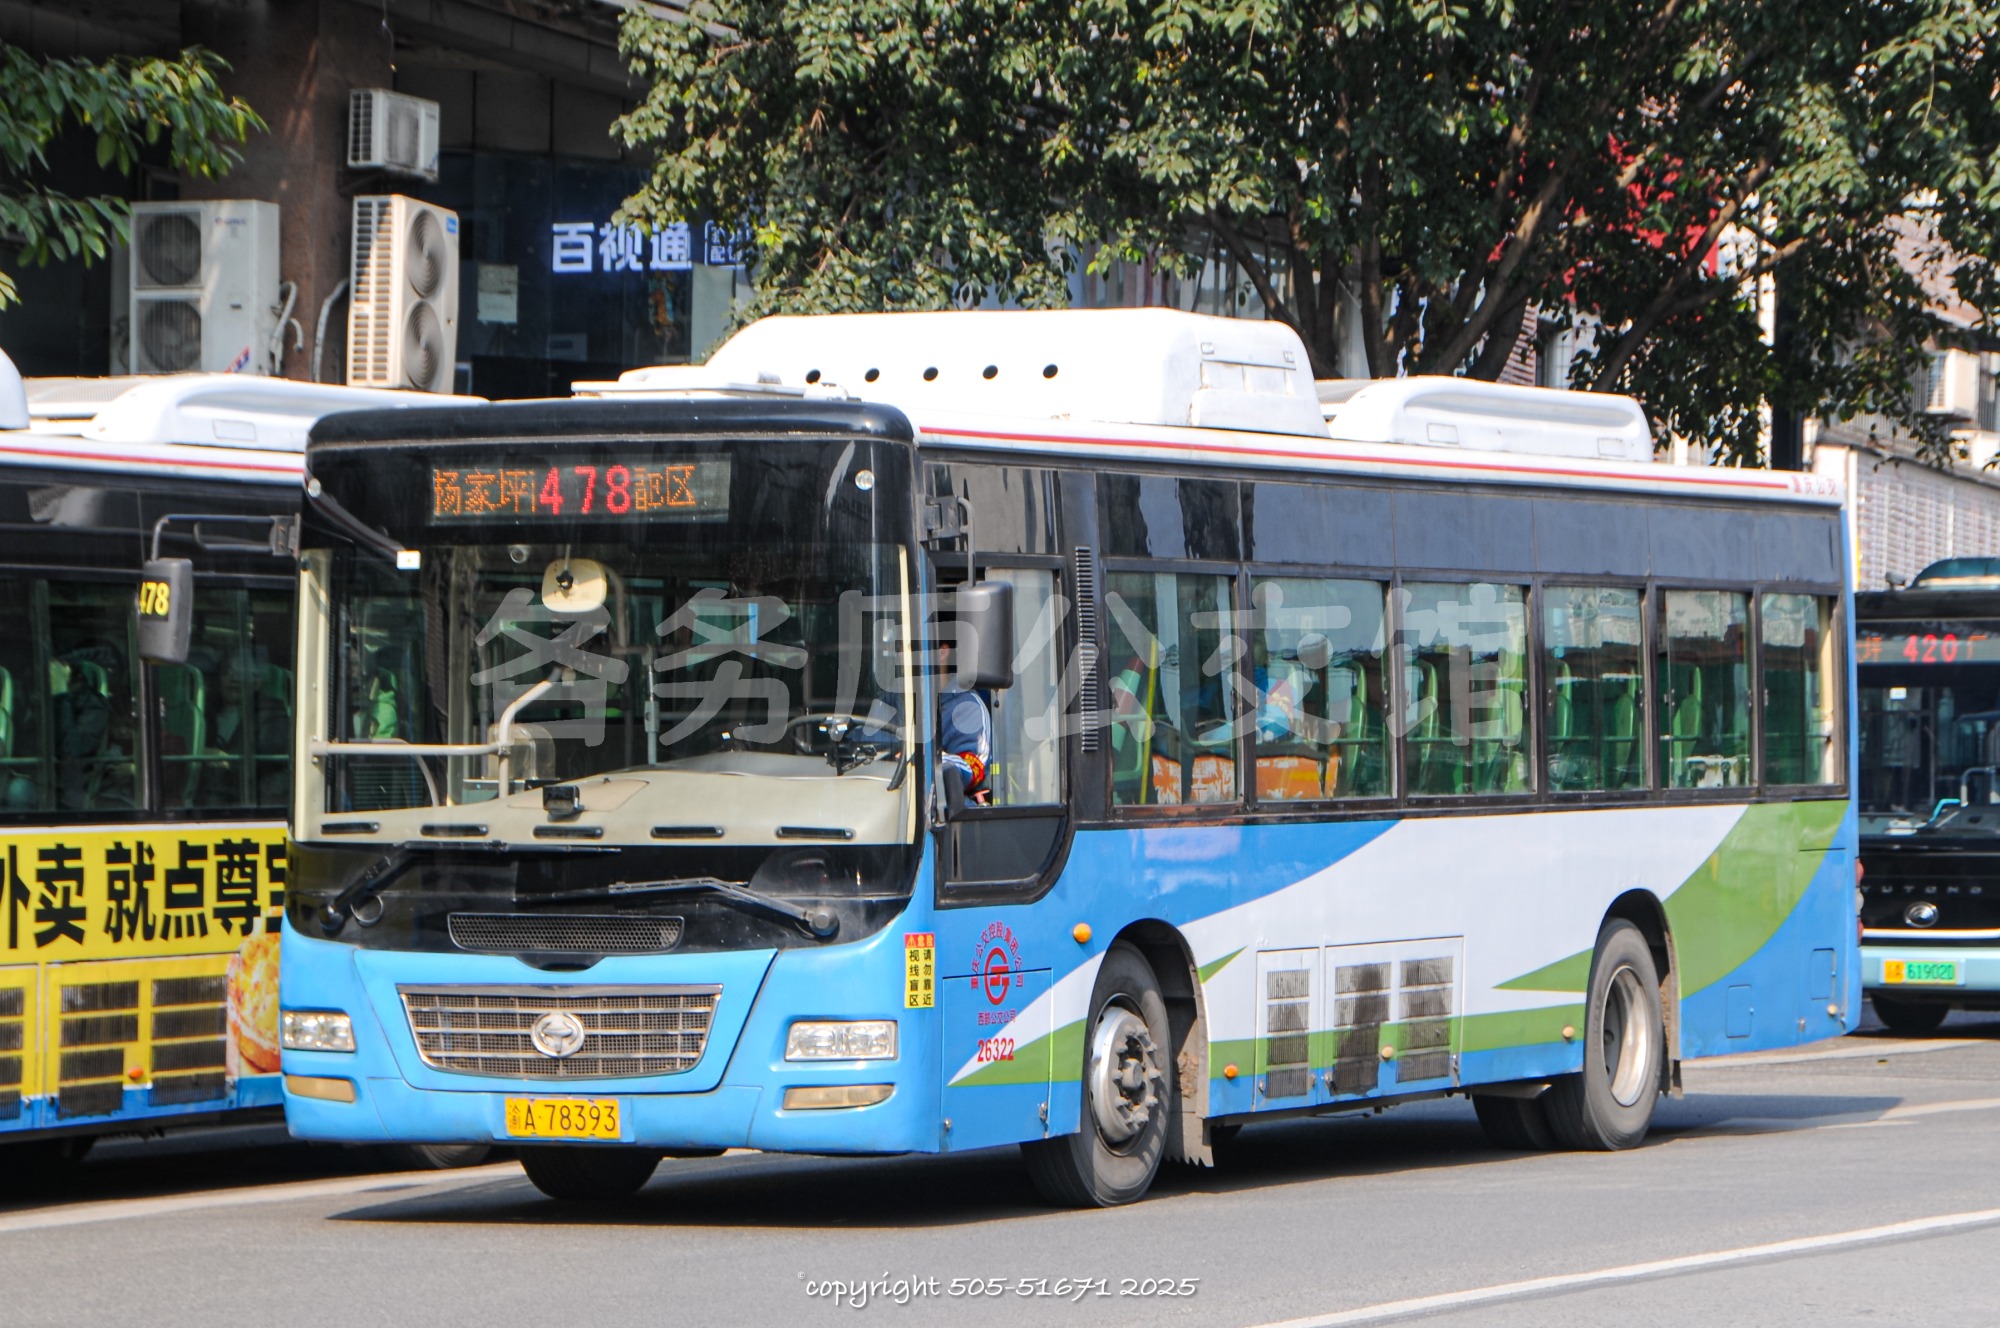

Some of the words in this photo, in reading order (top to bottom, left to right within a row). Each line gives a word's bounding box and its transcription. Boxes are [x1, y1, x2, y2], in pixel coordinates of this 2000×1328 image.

[552, 222, 692, 273] 百视通
[434, 467, 537, 516] 杨家坪
[539, 464, 631, 516] 478
[1903, 633, 1957, 663] 420
[909, 949, 919, 1007] 视线盲区
[923, 949, 932, 1006] 请勿靠近
[978, 1009, 1017, 1026] 西部公交公司
[977, 1037, 1014, 1062] 26322
